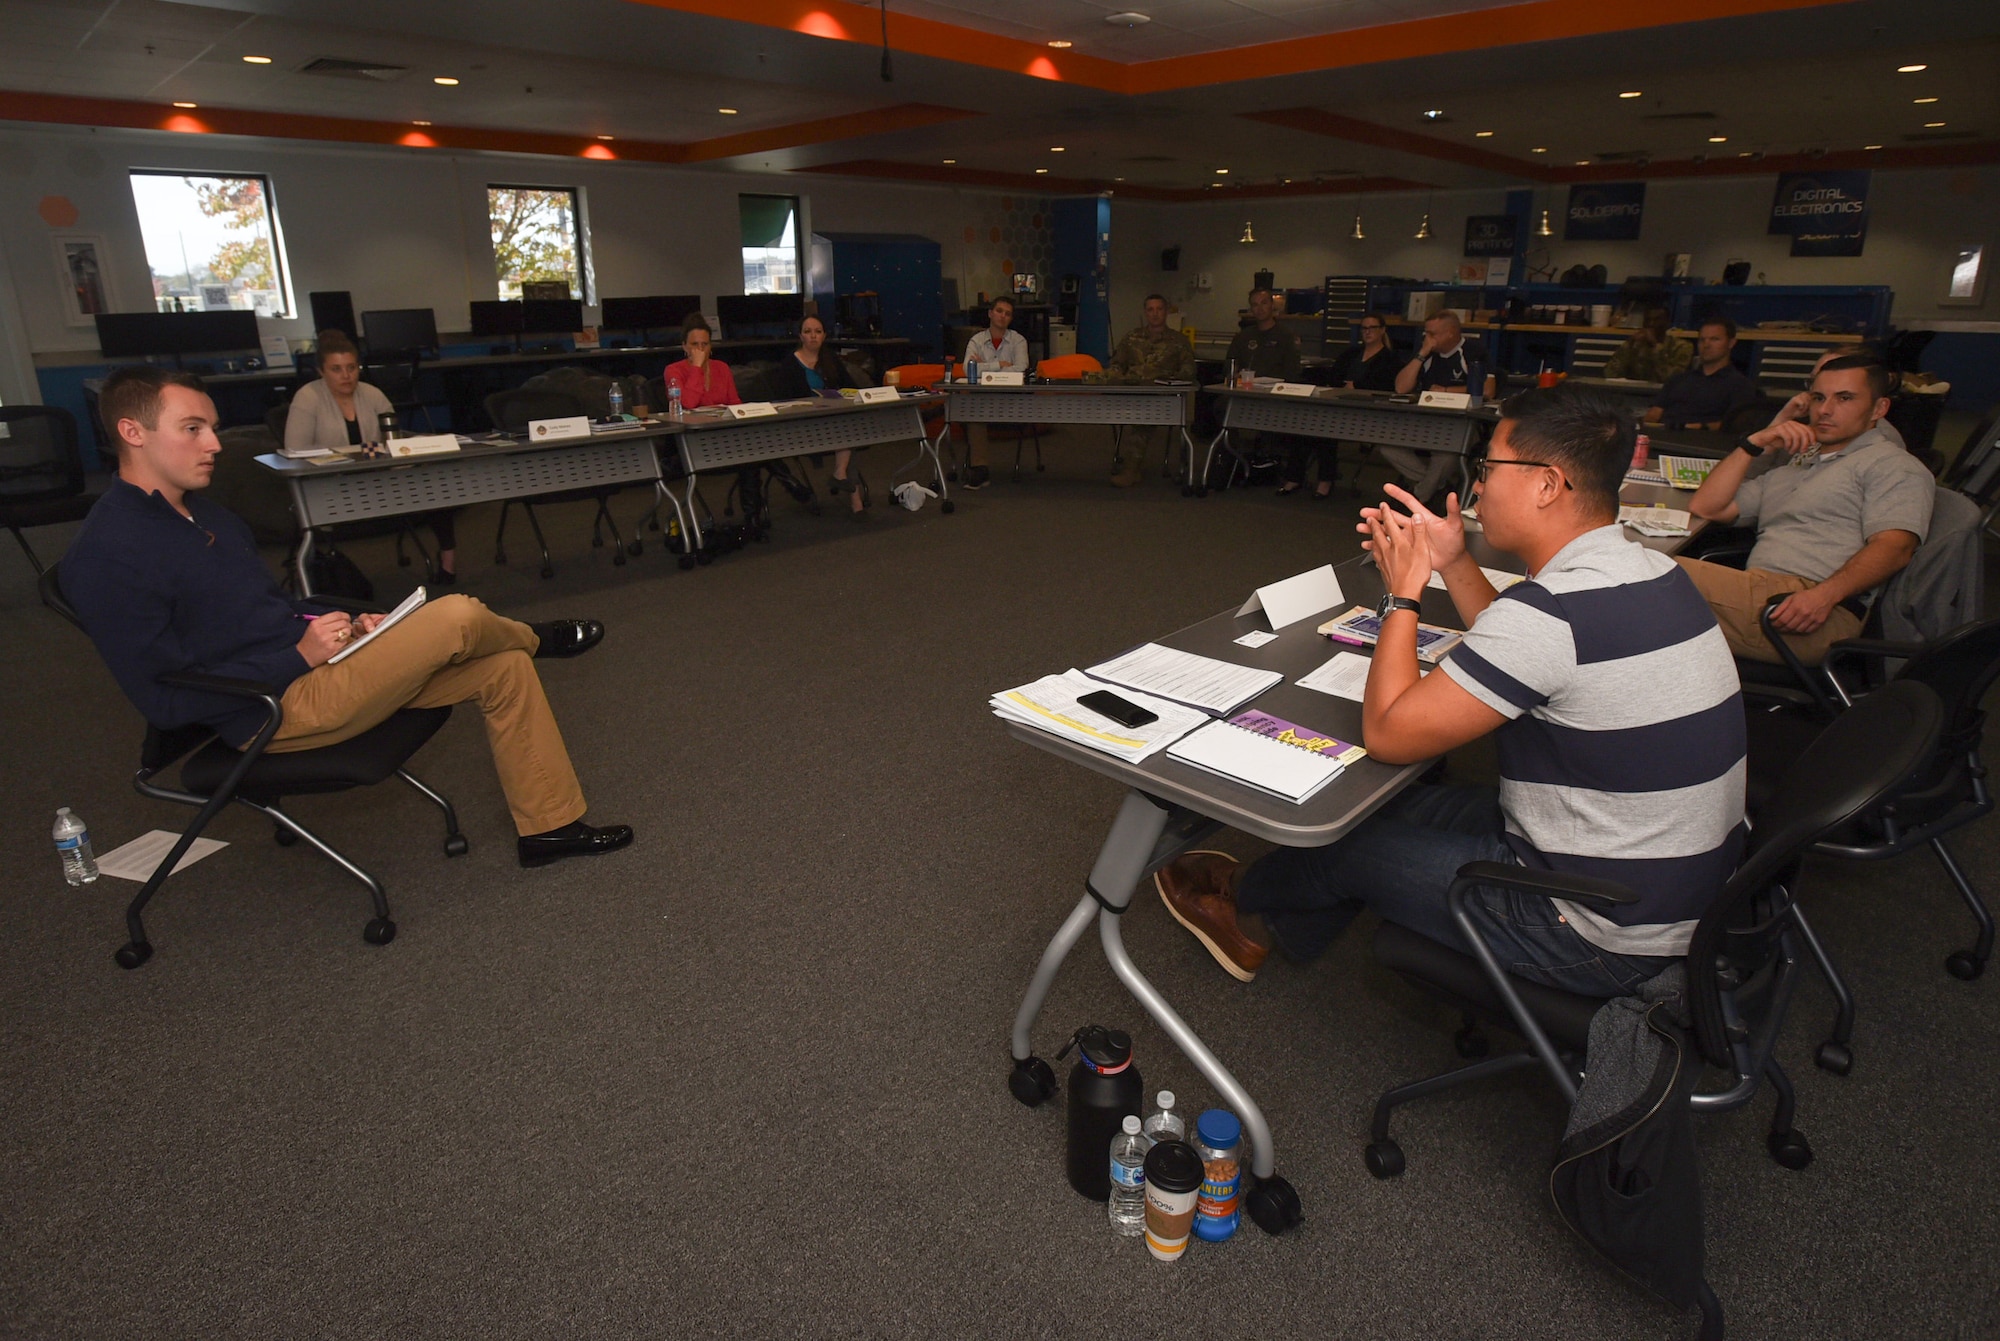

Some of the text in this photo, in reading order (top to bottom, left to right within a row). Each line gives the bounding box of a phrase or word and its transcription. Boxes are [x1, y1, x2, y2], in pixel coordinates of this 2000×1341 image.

[1794, 188, 1846, 201] DIGITAL
[1570, 203, 1640, 219] SOLDERING
[1774, 201, 1863, 216] ELECTRONICS
[1479, 223, 1498, 236] 3D
[1467, 239, 1513, 250] PRINTING
[1200, 1182, 1233, 1196] ANTERS
[1149, 1193, 1174, 1211] 100%
